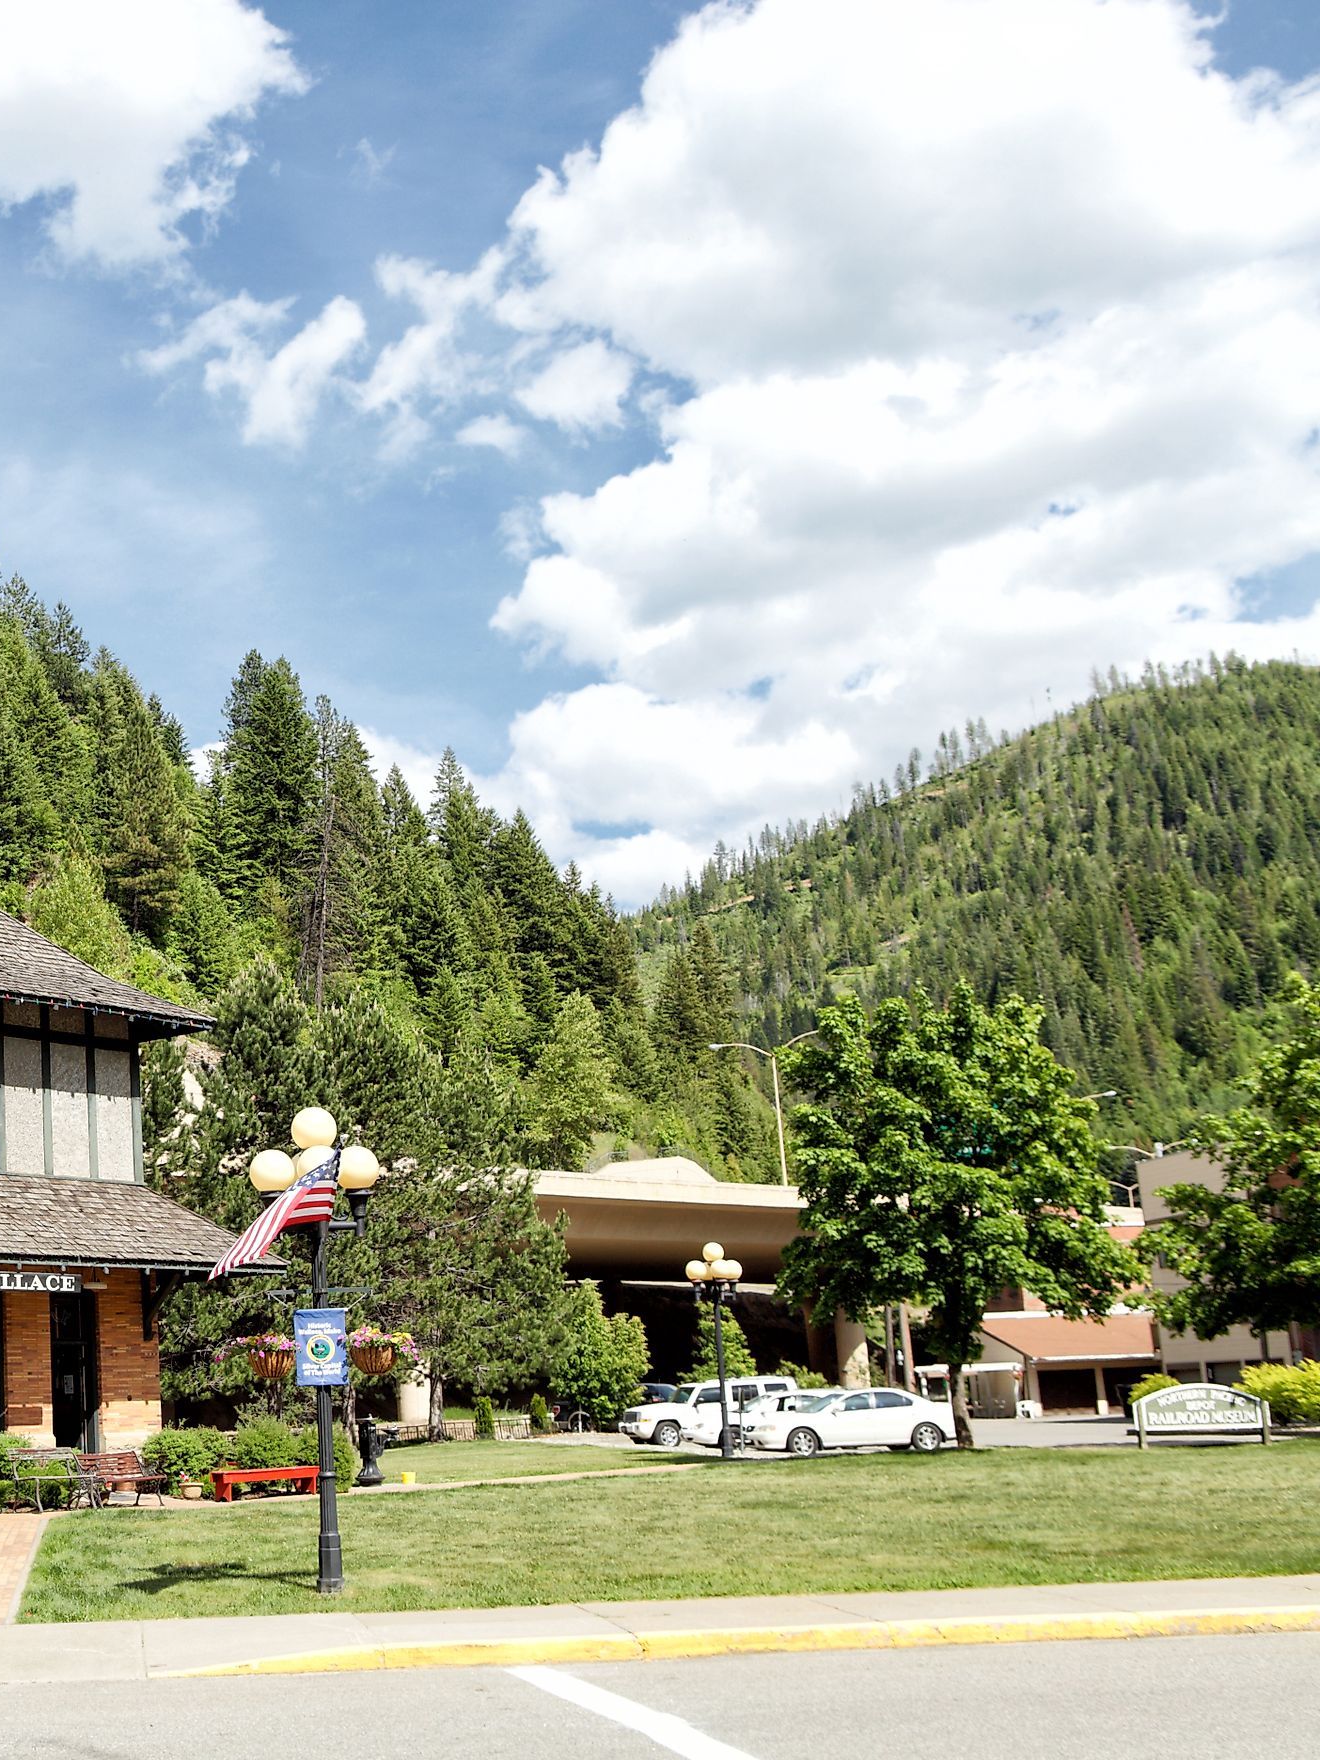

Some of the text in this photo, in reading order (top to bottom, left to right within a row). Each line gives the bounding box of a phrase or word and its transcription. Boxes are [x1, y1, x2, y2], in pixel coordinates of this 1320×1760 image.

[1156, 1389, 1207, 1408] NORTHERN
[1185, 1400, 1216, 1411] DEPOT
[1147, 1411, 1256, 1425] RAILROAD MUSEUM
